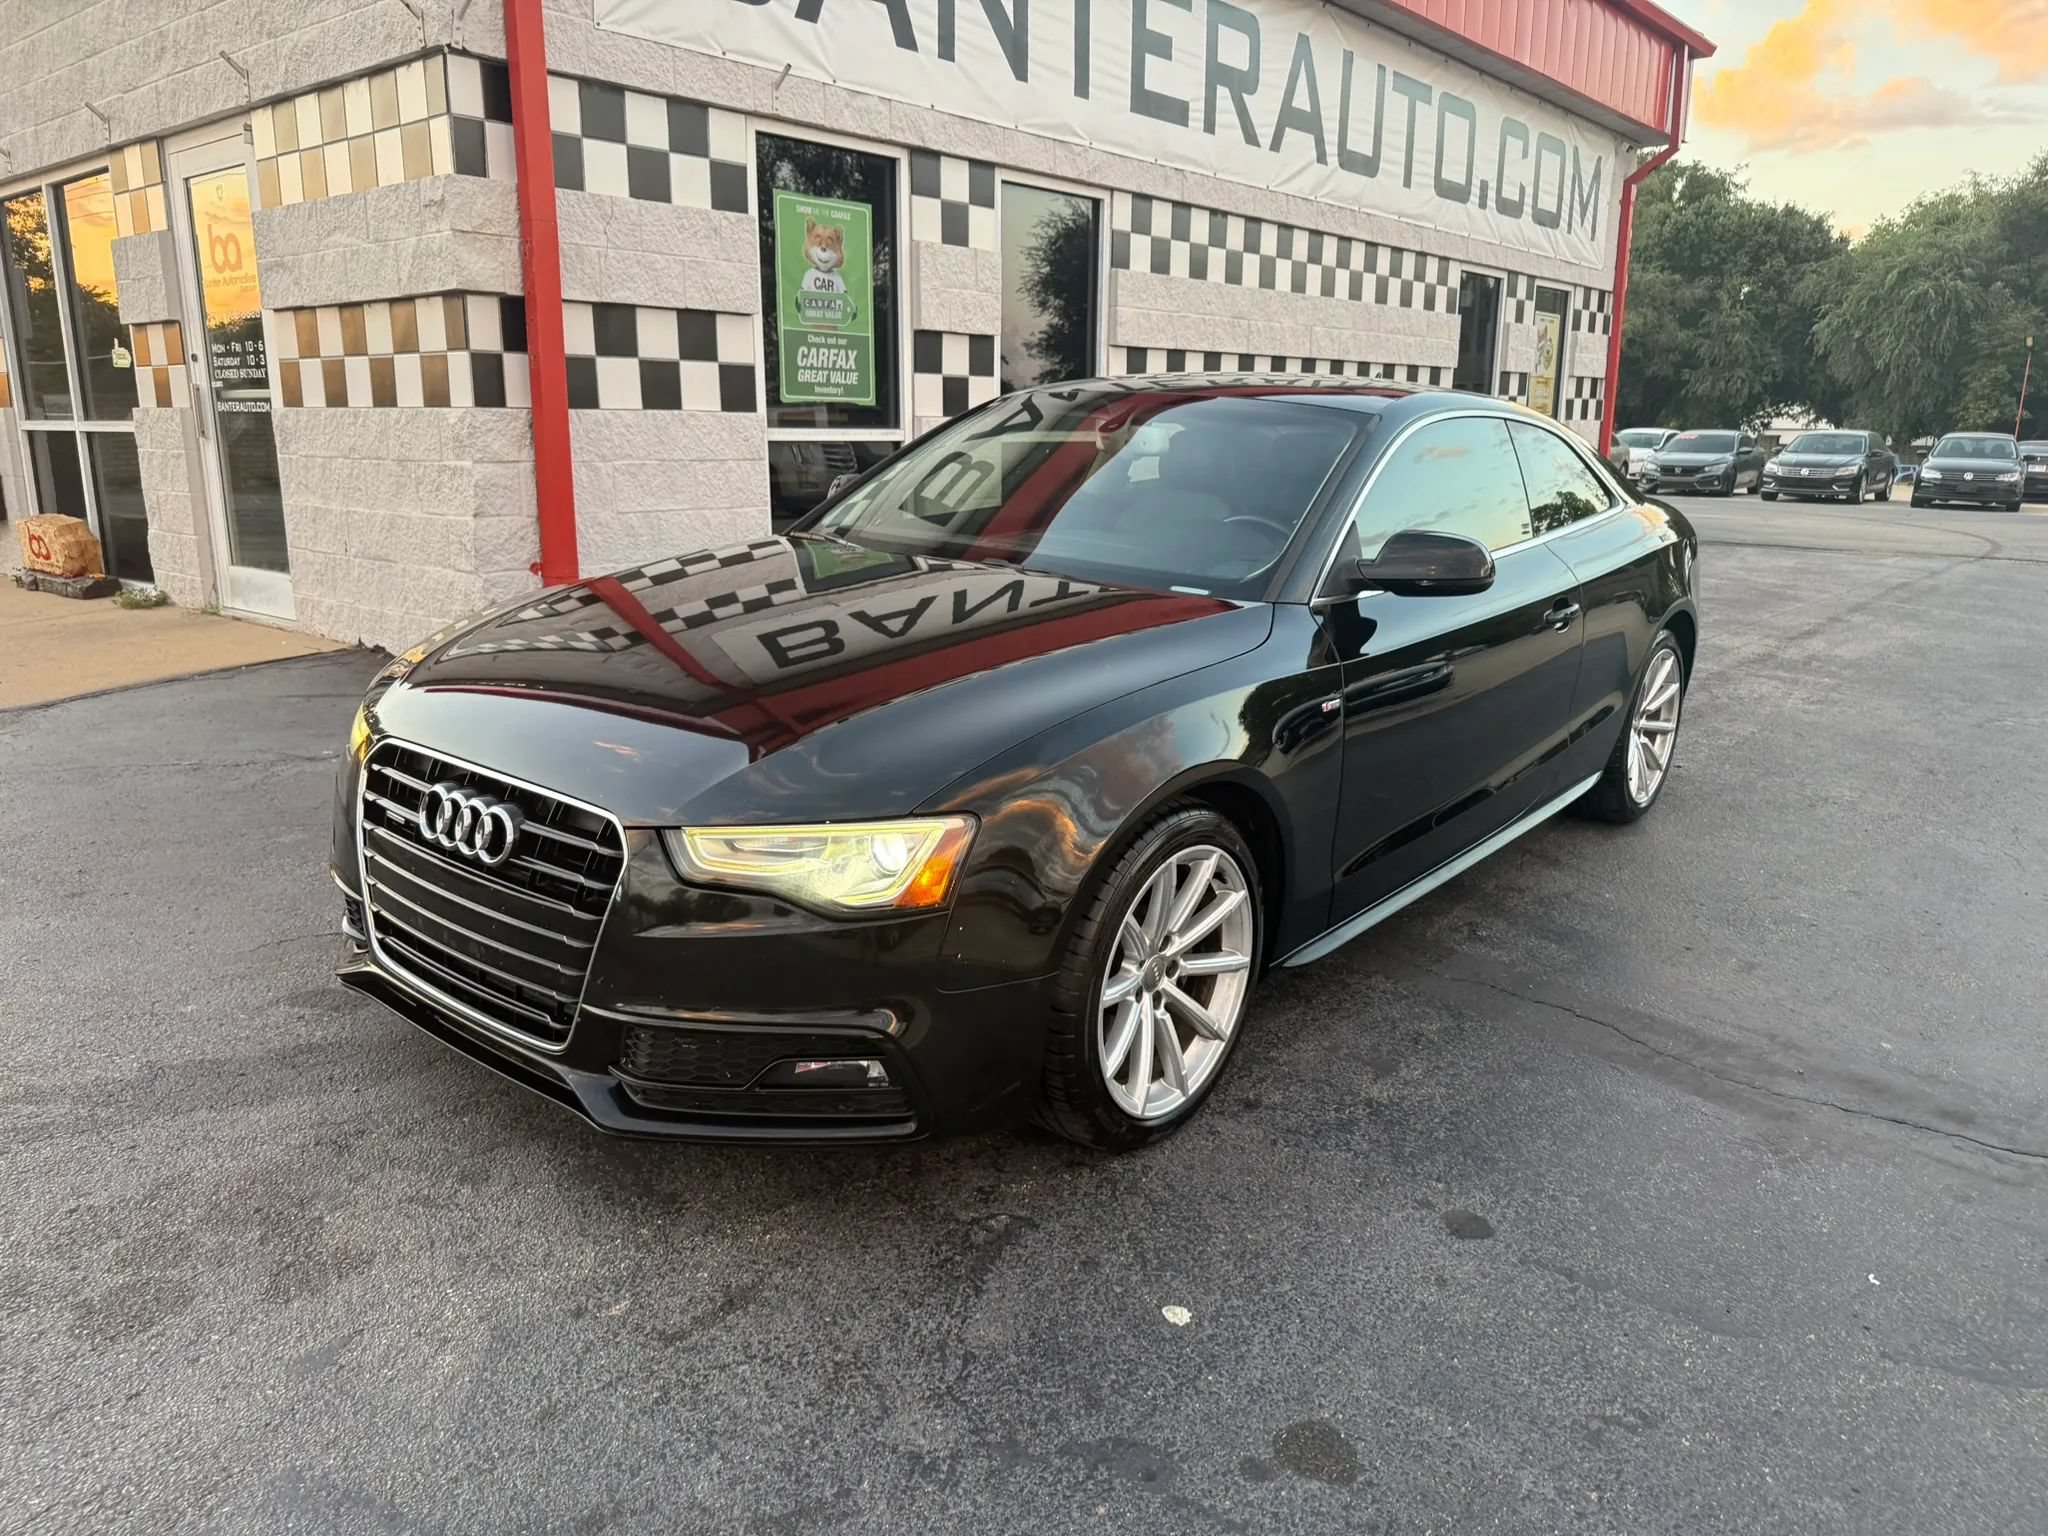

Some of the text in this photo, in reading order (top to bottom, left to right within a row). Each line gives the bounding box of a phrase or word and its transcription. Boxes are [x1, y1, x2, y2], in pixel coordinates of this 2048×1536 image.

[732, 0, 1604, 242] NERAUTO.COM
[814, 277, 835, 292] CAR
[804, 298, 843, 311] CARFAX
[805, 310, 842, 320] GREAT VALUE
[807, 334, 826, 344] Check
[826, 336, 837, 345] out
[797, 346, 858, 370] CARFAX
[214, 368, 267, 379] CLOSED SUNDAY
[798, 368, 859, 385] GREAT VALUE
[814, 385, 844, 396] Inventory!
[217, 401, 271, 412] BANTERAUTO.COM
